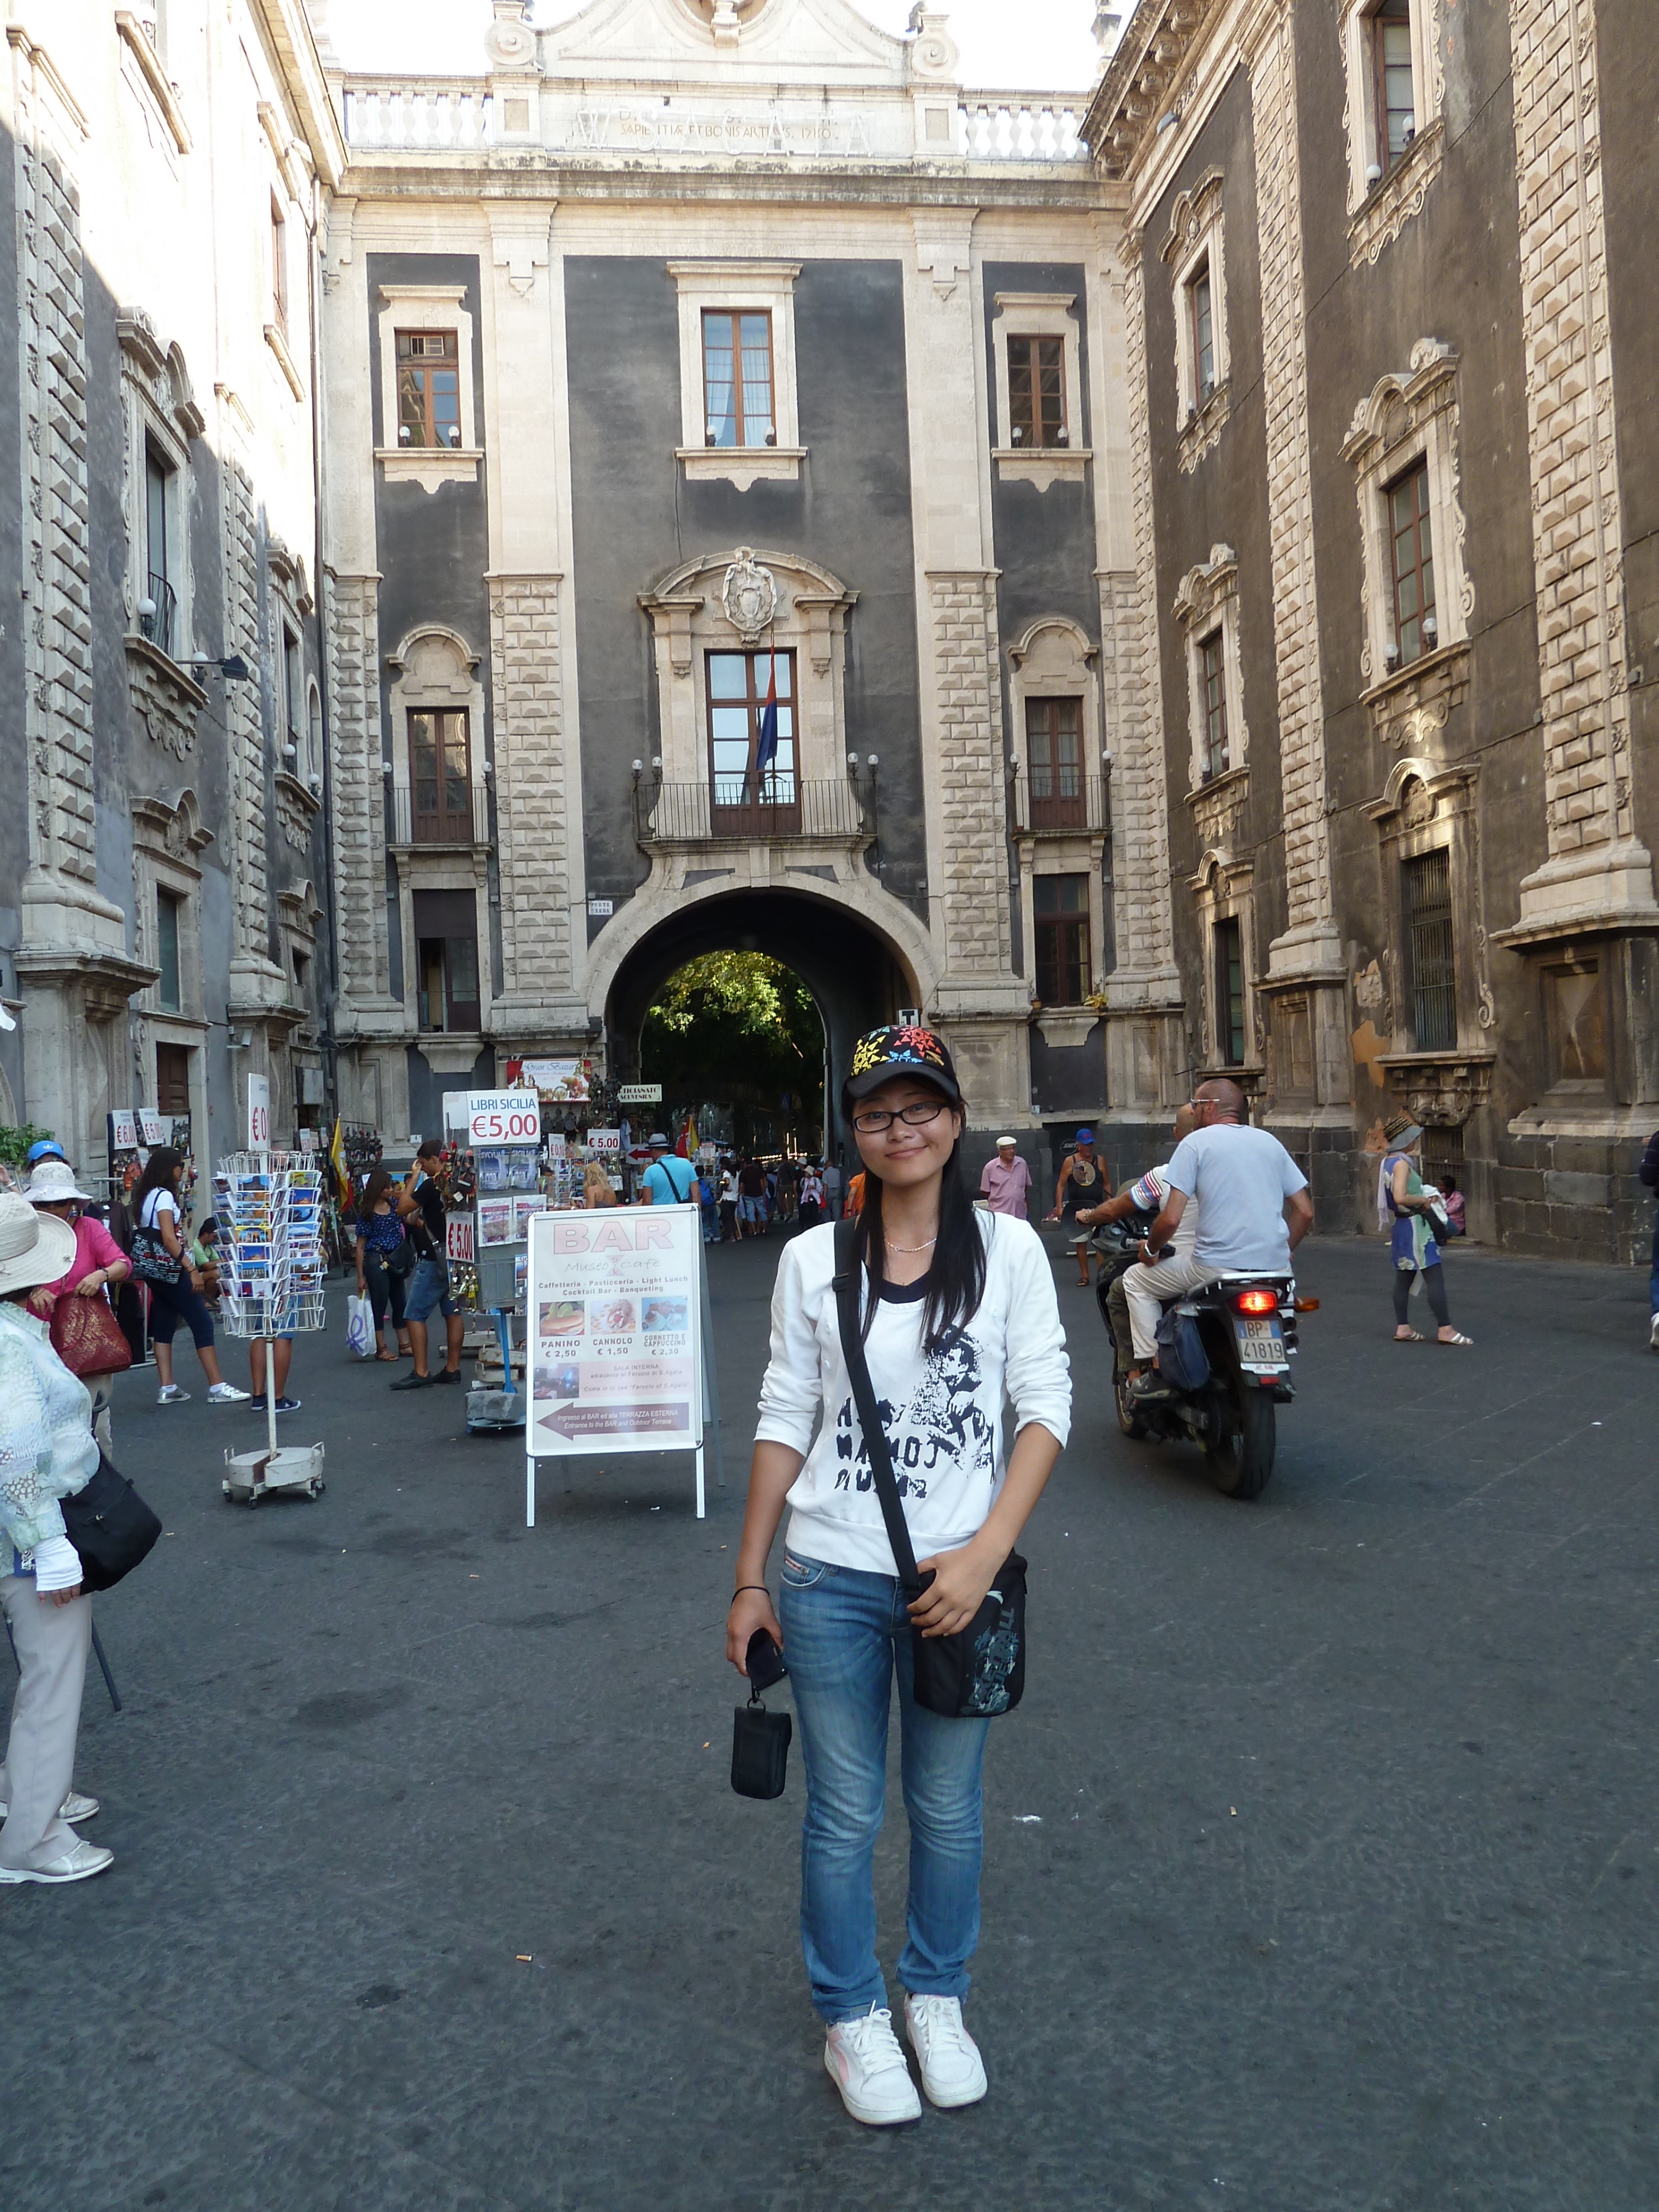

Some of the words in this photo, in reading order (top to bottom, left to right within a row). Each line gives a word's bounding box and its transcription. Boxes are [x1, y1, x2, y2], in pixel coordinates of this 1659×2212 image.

[471, 1099, 498, 1110] LIBRI
[500, 1098, 535, 1110] SICILIA
[471, 1114, 537, 1140] €5,00
[553, 1218, 674, 1255] BAR
[565, 1262, 608, 1272] Museo
[619, 1285, 663, 1294] Banqueting
[1247, 1321, 1262, 1337] BP
[541, 1340, 580, 1348] PANINO
[593, 1337, 632, 1346] CANNOLO
[1244, 1342, 1283, 1359] 41819
